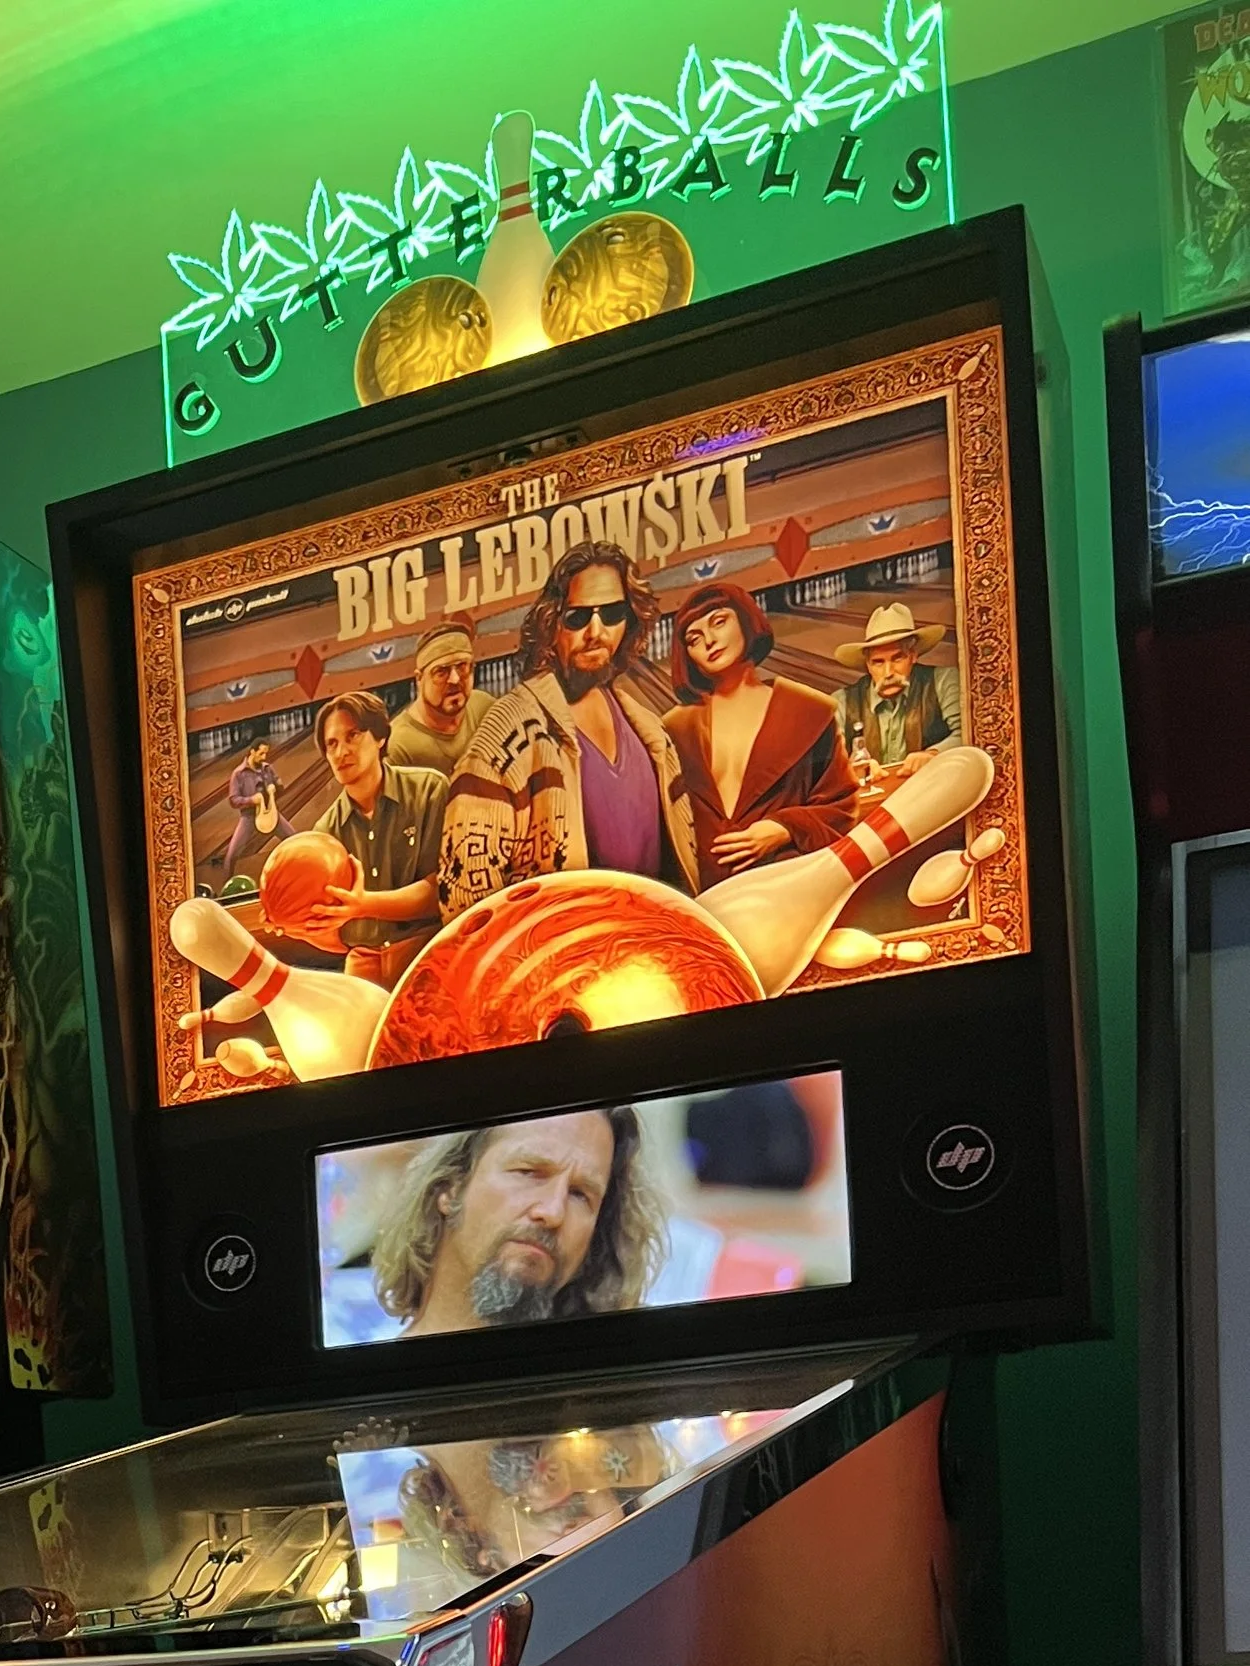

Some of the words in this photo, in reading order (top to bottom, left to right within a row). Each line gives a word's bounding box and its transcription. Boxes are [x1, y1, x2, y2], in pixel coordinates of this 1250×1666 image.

[174, 133, 940, 435] GUTTERBALLS
[502, 473, 559, 516] THE
[333, 547, 429, 641] BIG
